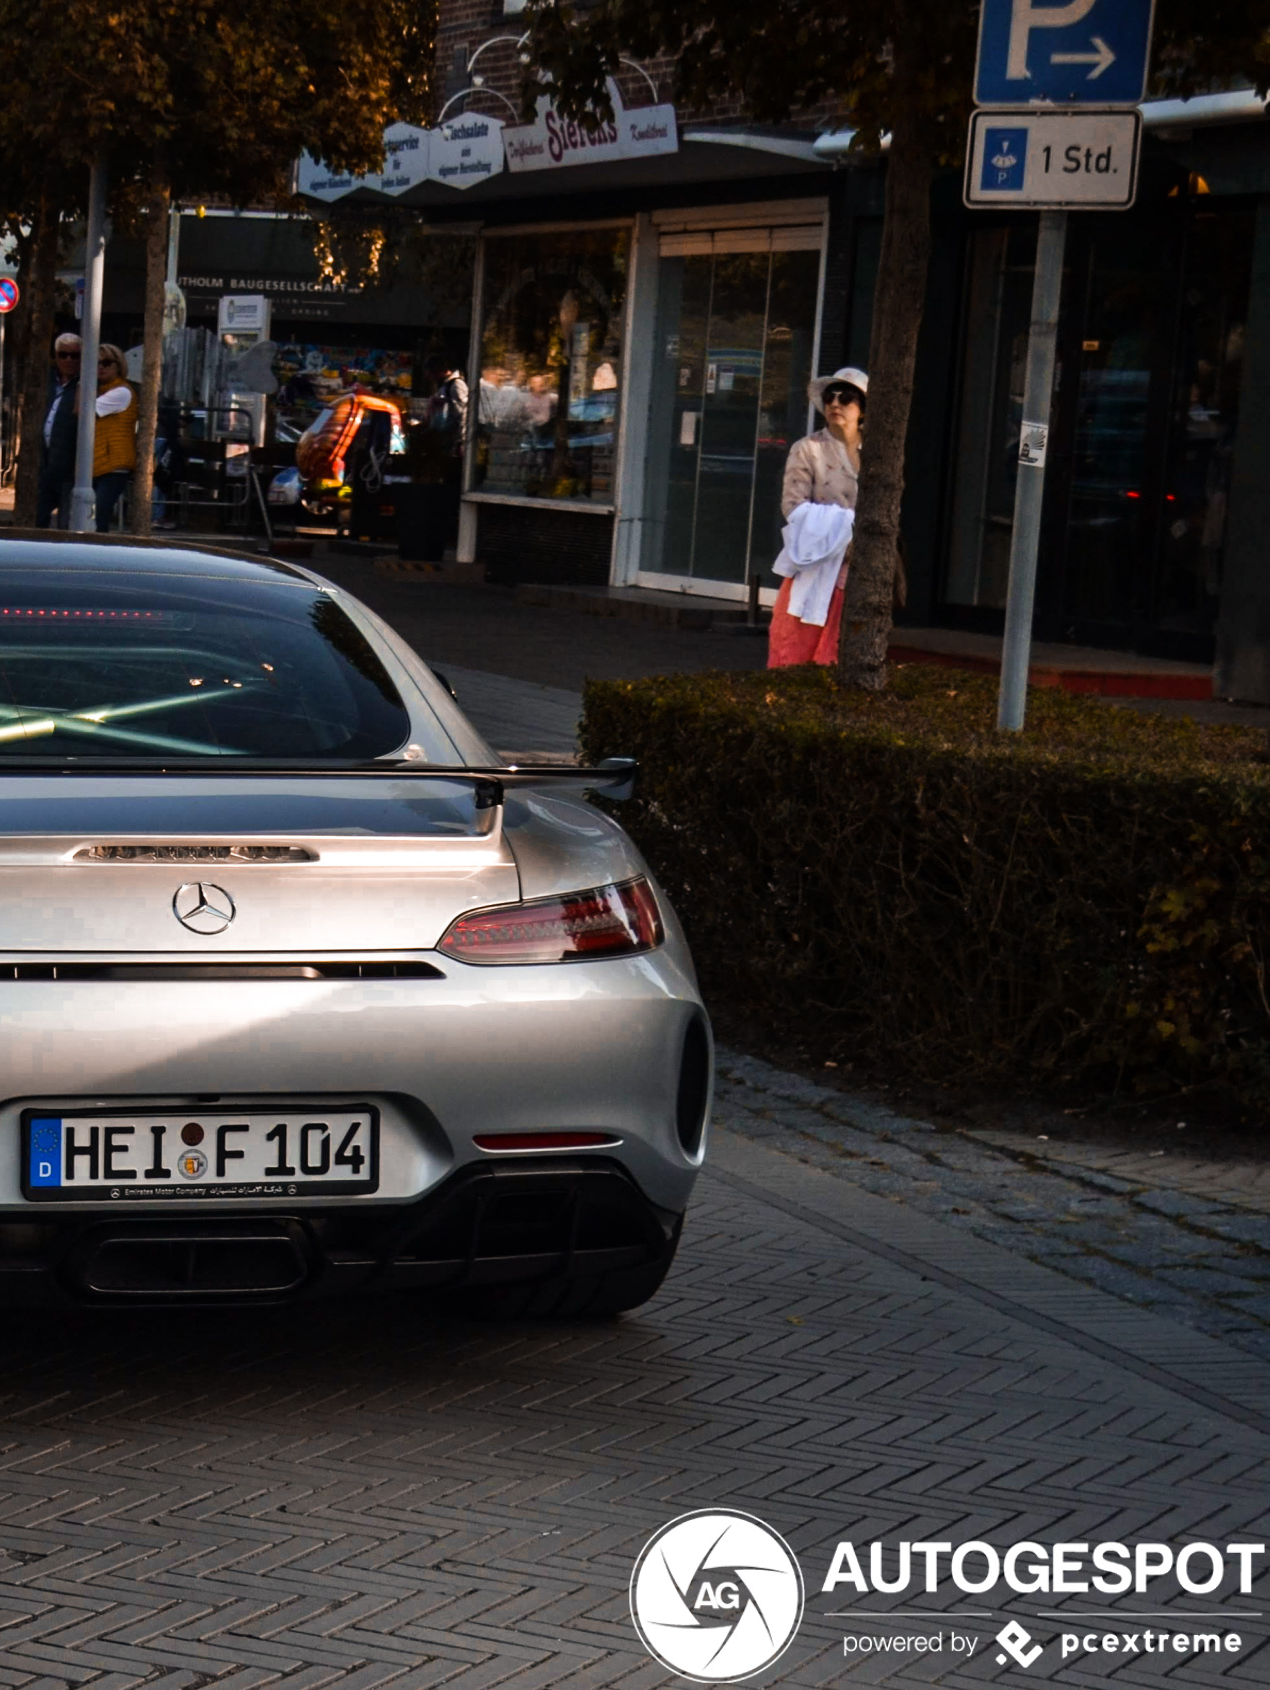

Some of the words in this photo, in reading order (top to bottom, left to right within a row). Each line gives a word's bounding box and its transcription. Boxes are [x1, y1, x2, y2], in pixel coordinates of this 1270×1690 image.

[1006, 0, 1096, 80] P
[1042, 145, 1051, 174] 1
[1063, 145, 1118, 174] Std.
[998, 171, 1007, 185] P
[230, 278, 347, 294] BAUGESELLSCHAFT
[65, 1126, 172, 1180] HEI
[216, 1124, 250, 1177] F
[265, 1121, 365, 1177] 104
[39, 1161, 52, 1178] D
[124, 1188, 154, 1196] Emirates
[155, 1187, 175, 1195] Motor
[175, 1187, 207, 1196] Company
